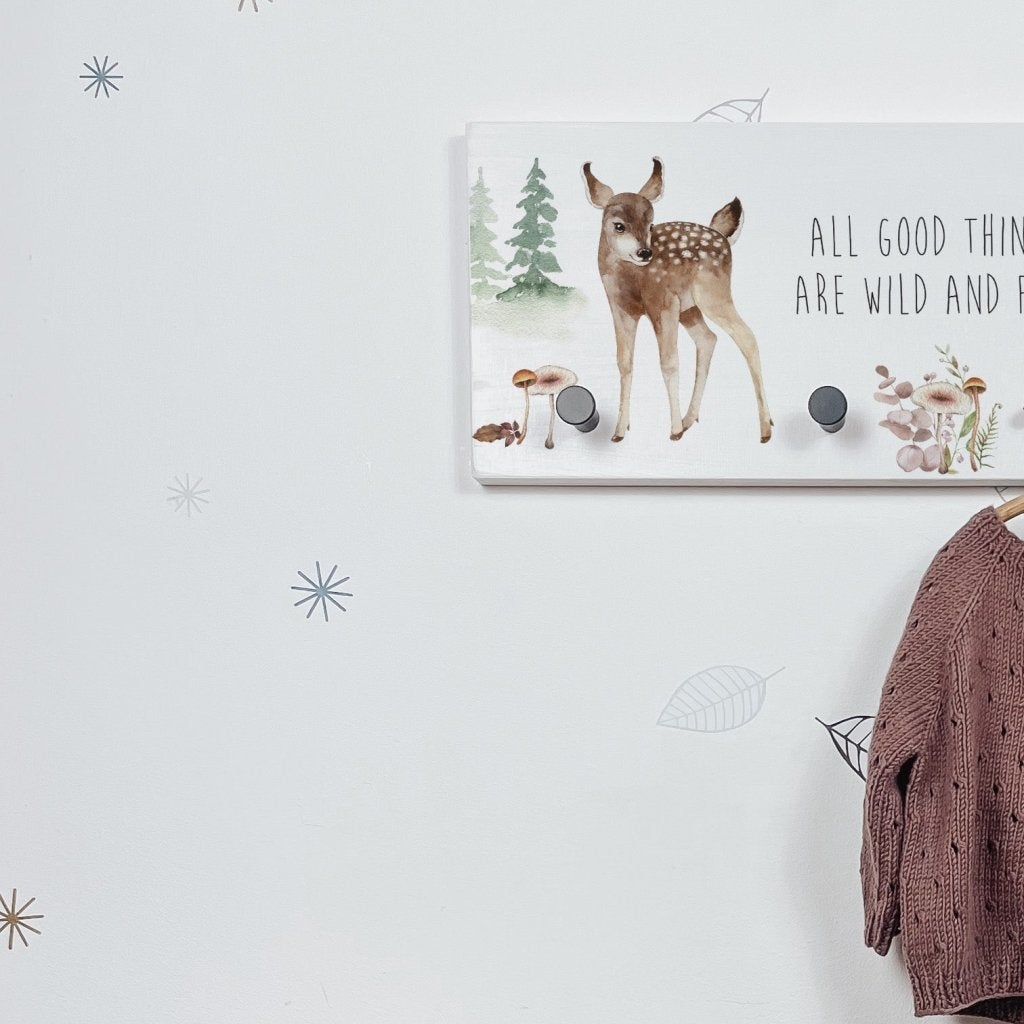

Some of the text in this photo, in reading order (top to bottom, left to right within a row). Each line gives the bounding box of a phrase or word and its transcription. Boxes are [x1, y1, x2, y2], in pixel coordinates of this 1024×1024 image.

[811, 215, 859, 257] ALL
[878, 214, 946, 257] GOOD
[796, 272, 844, 315] ARE
[864, 272, 927, 315] WILD
[946, 273, 999, 315] AND
